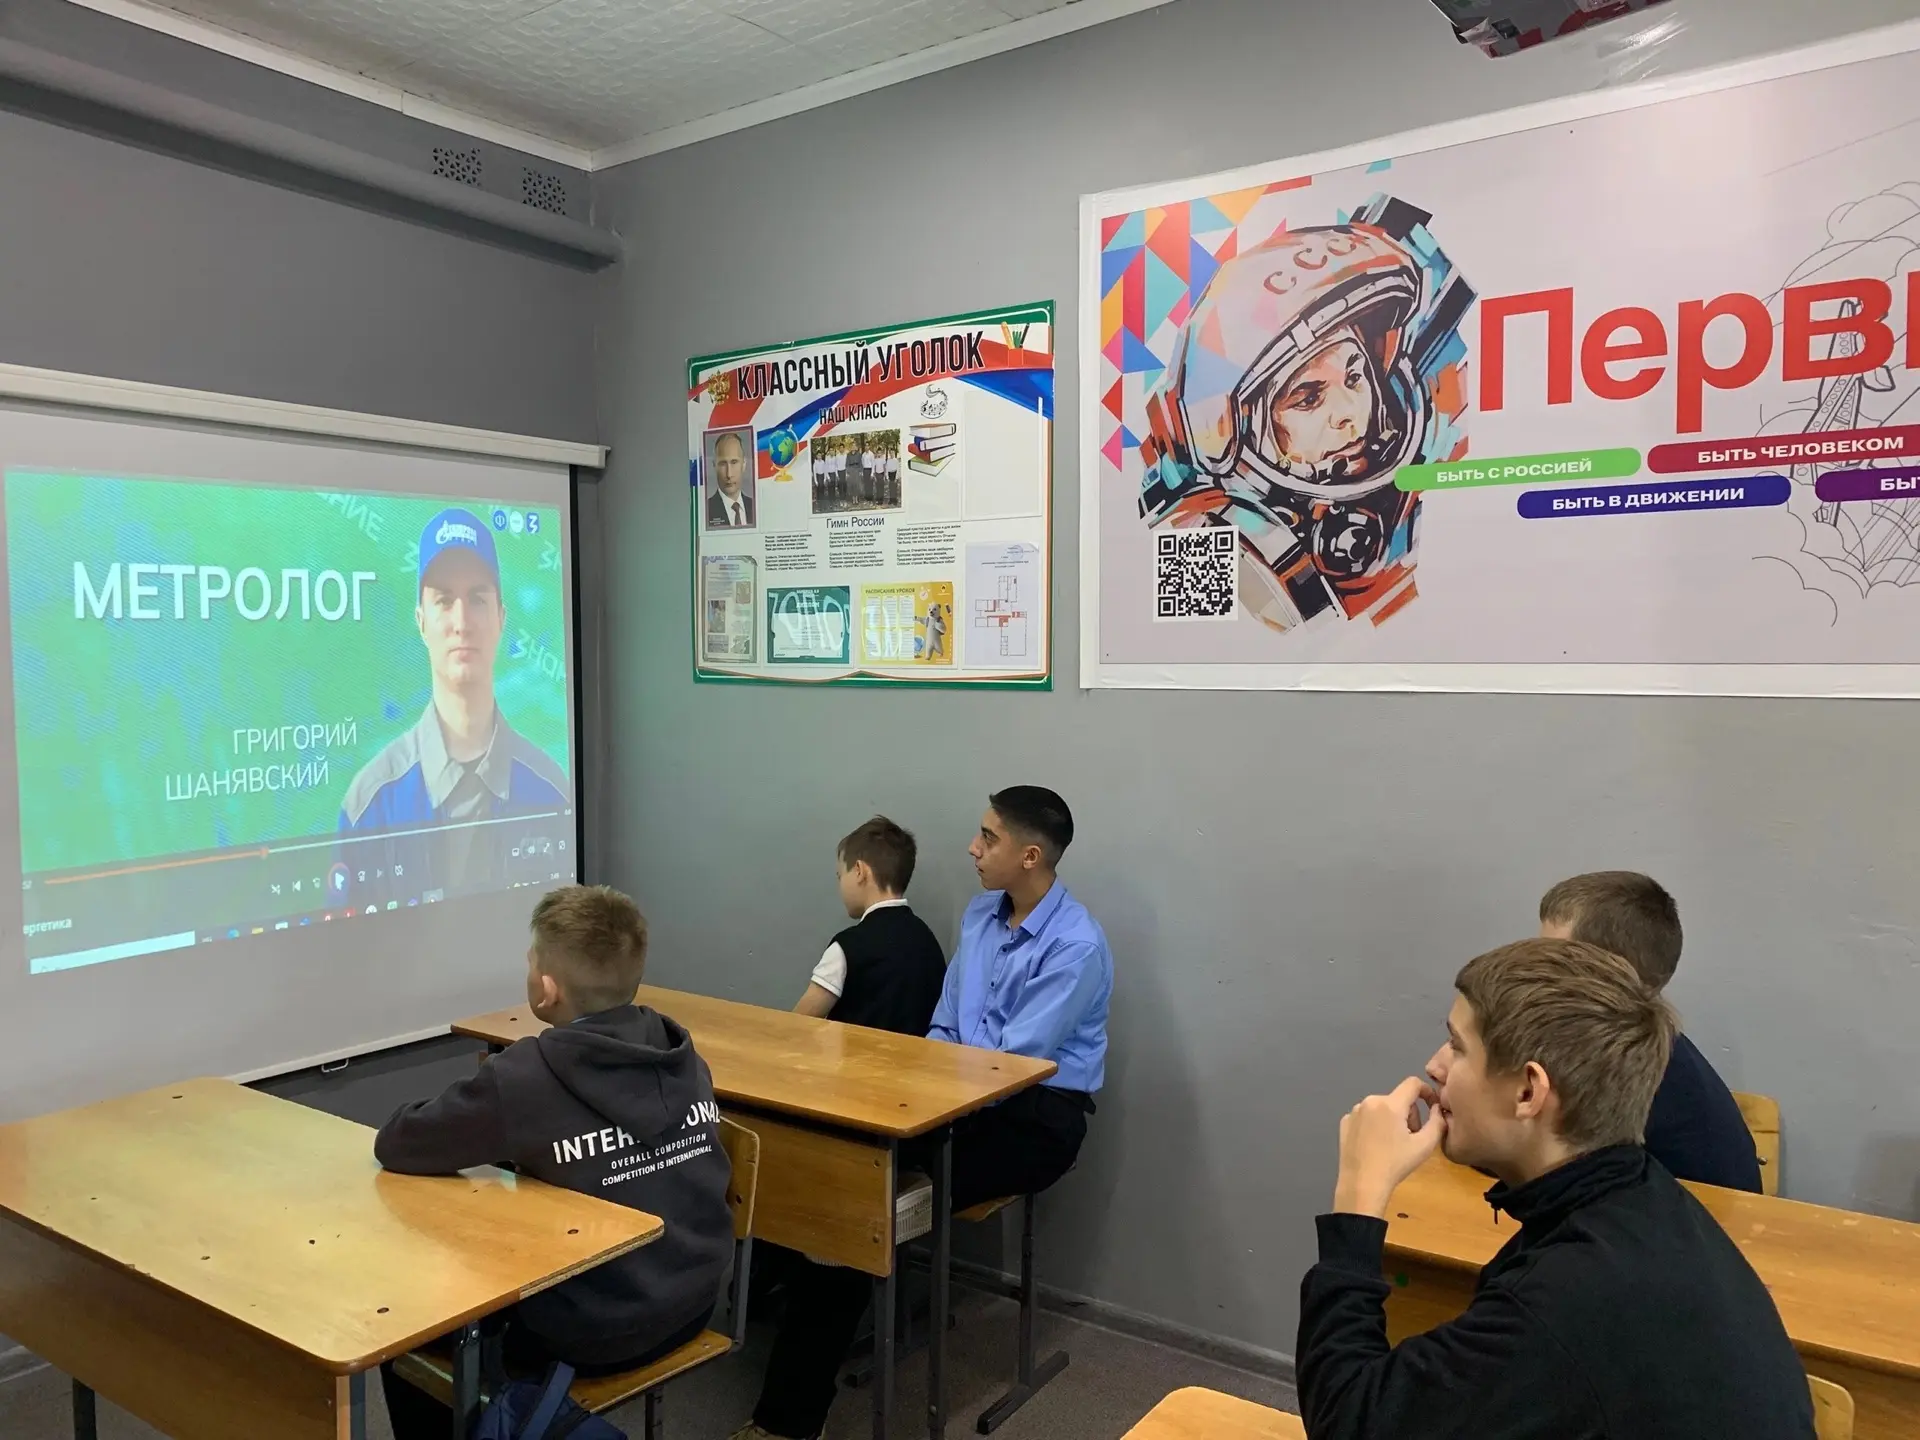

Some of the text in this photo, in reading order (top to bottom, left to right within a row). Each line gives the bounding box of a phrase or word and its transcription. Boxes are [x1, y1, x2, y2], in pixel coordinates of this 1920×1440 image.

[737, 330, 985, 400] КЛАССНЫЙ УГОЛОК
[819, 401, 887, 425] НАШ КЛАСС
[1698, 437, 1904, 464] БЫТЬ ЧЕЛОВЕКОМ
[1436, 457, 1593, 483] БЫТЬ С РОССИЕЙ
[1880, 477, 1920, 492] БЫ
[1552, 487, 1745, 511] БЫТЬ В ДВИЖЕНИИ
[826, 516, 885, 529] Гимн России
[73, 561, 376, 621] МЕТРОЛОГ
[233, 716, 357, 755] ГРИГОРИЙ
[165, 755, 329, 801] ШАНЯВСКИЙ
[601, 1144, 713, 1187] COMPETITION IS INTERNATIONAL
[611, 1132, 707, 1170] OVERALL COMPOSITION
